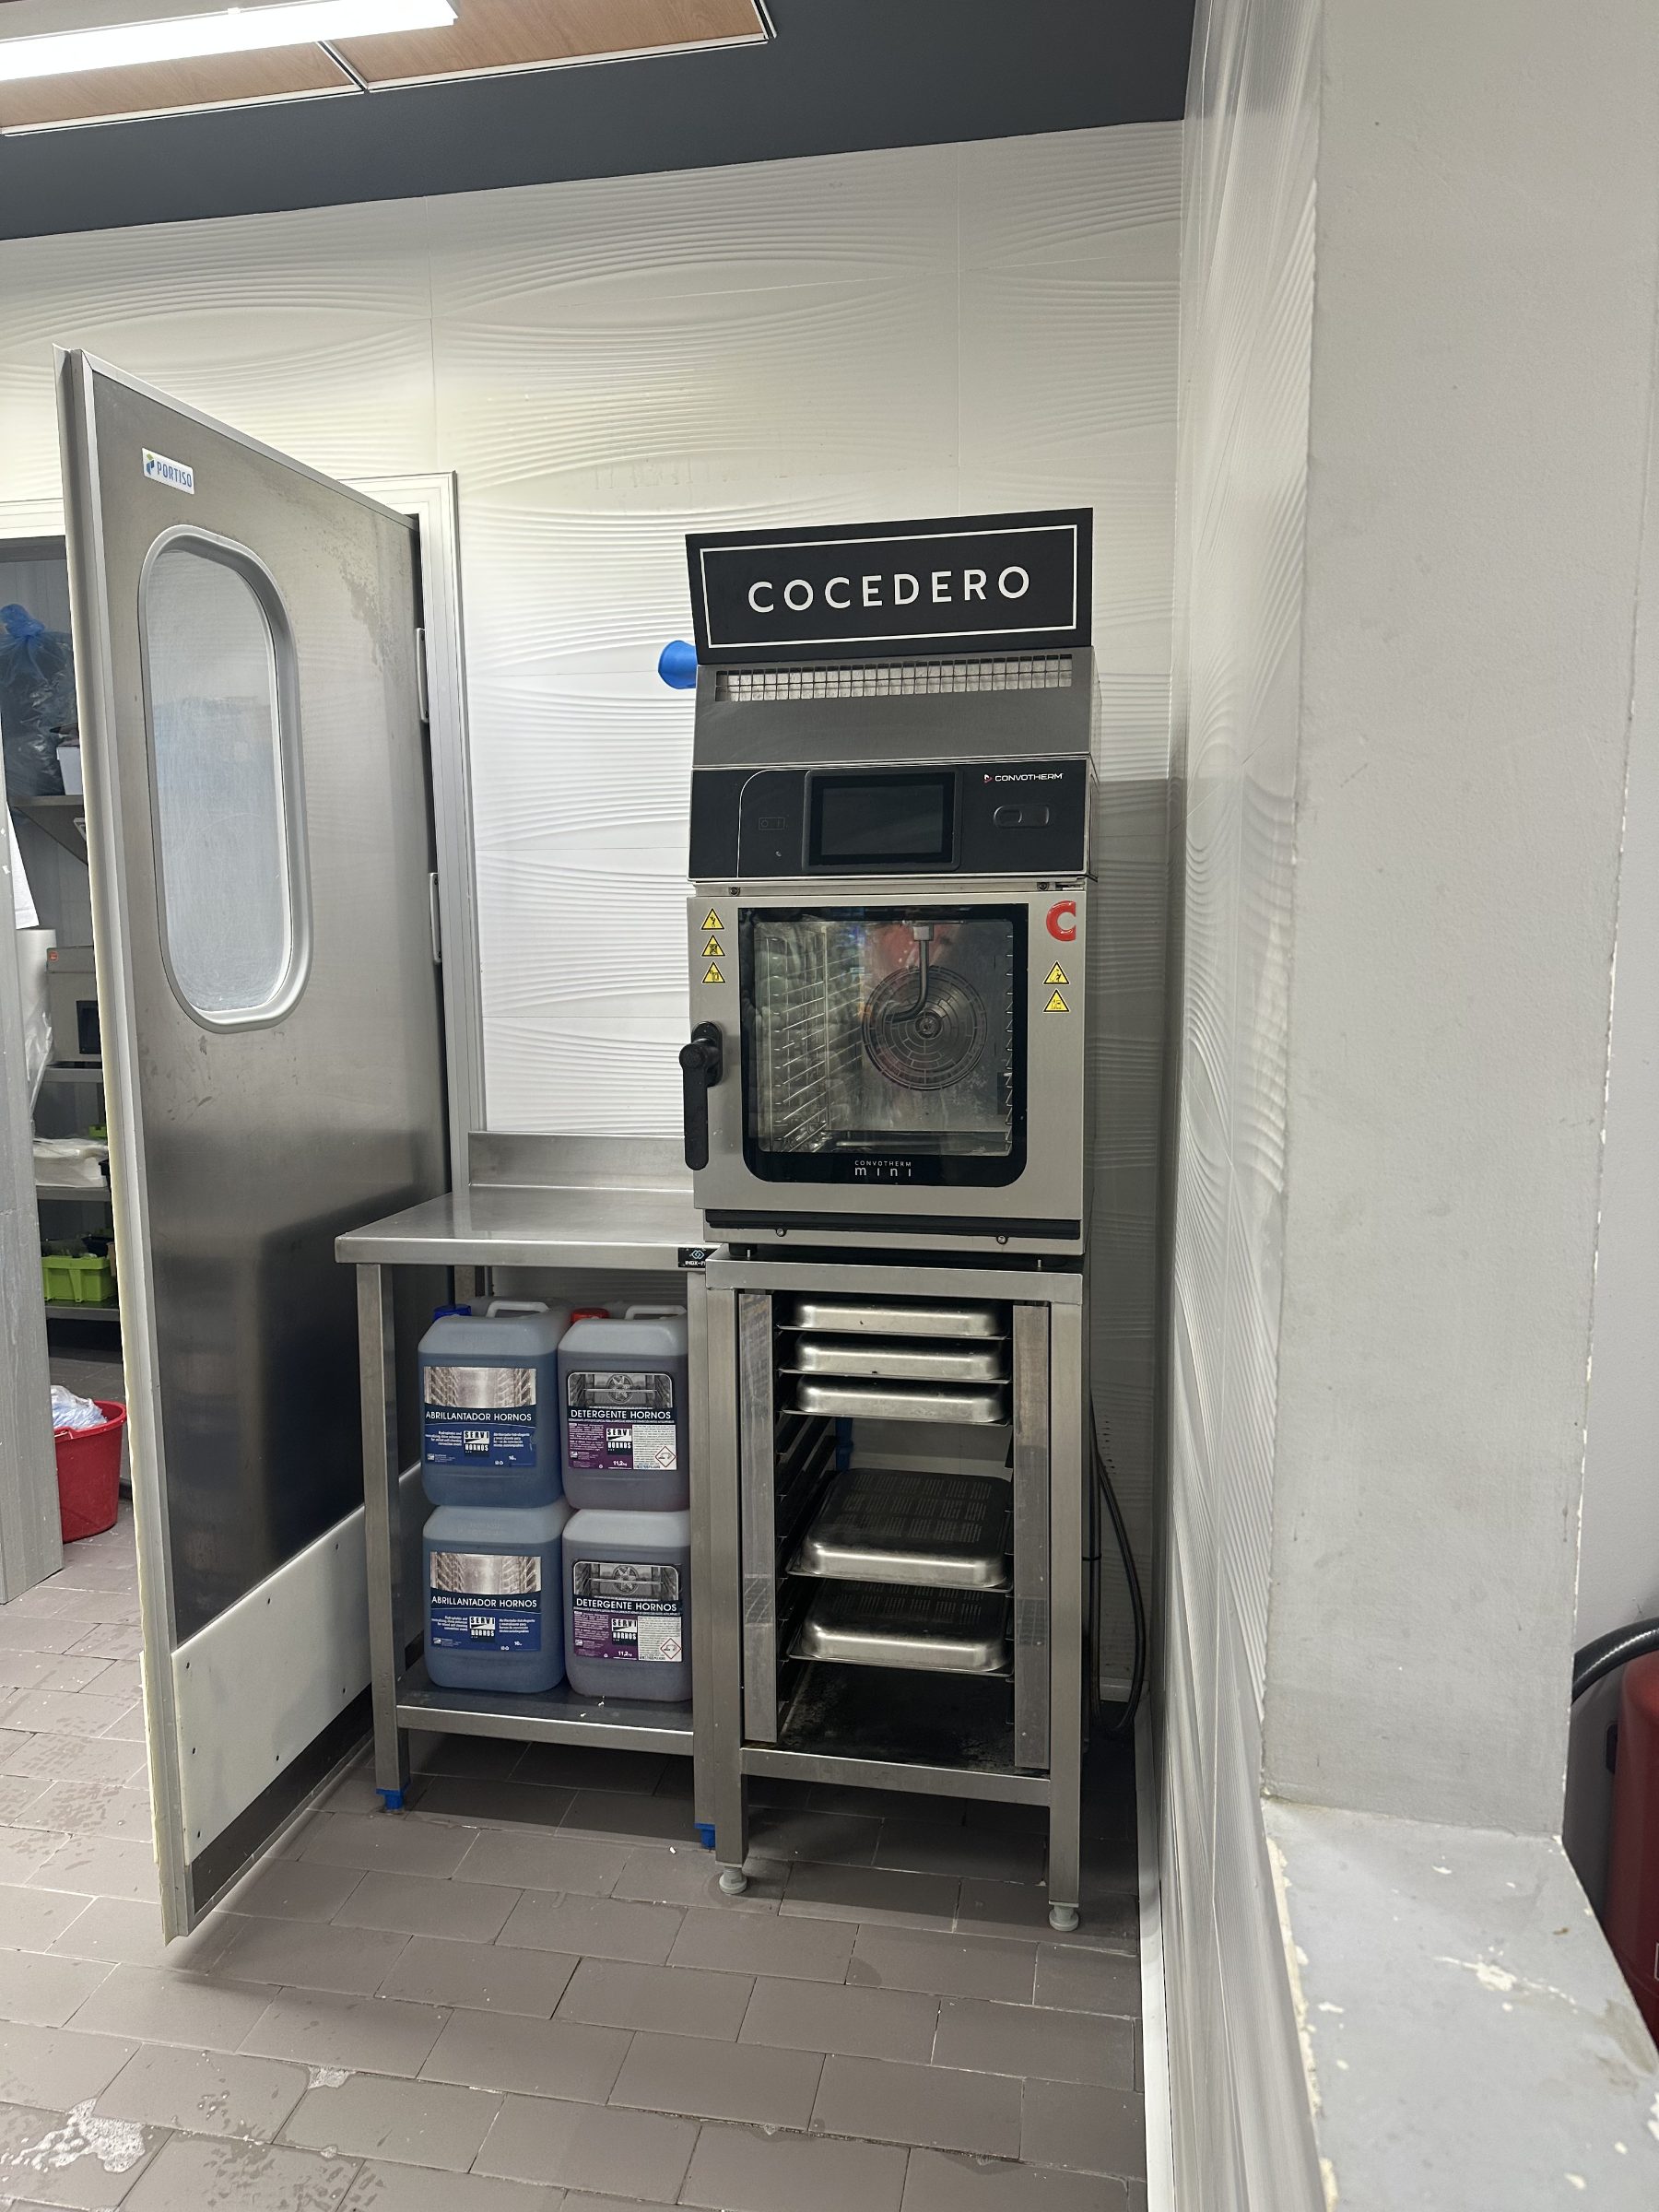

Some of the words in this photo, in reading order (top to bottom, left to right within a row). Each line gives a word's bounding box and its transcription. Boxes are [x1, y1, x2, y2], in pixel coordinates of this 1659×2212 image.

[157, 461, 193, 488] PORTISO
[747, 566, 1030, 613] COCEDERO
[994, 772, 1063, 782] CONVOTHERM
[426, 1411, 491, 1421] ABRILLANTADOR
[494, 1413, 532, 1421] HORNOS
[571, 1409, 627, 1418] DETERGENTE
[630, 1411, 671, 1419] HORNOS
[465, 1443, 488, 1452] HORNOS
[431, 1595, 497, 1607] ABRILLANTADOR
[500, 1599, 537, 1607] HORNOS
[576, 1598, 632, 1610] DETERGENTE
[635, 1602, 677, 1612] HORNOS
[612, 1618, 637, 1628] SERVI
[613, 1631, 637, 1641] HORNOS
